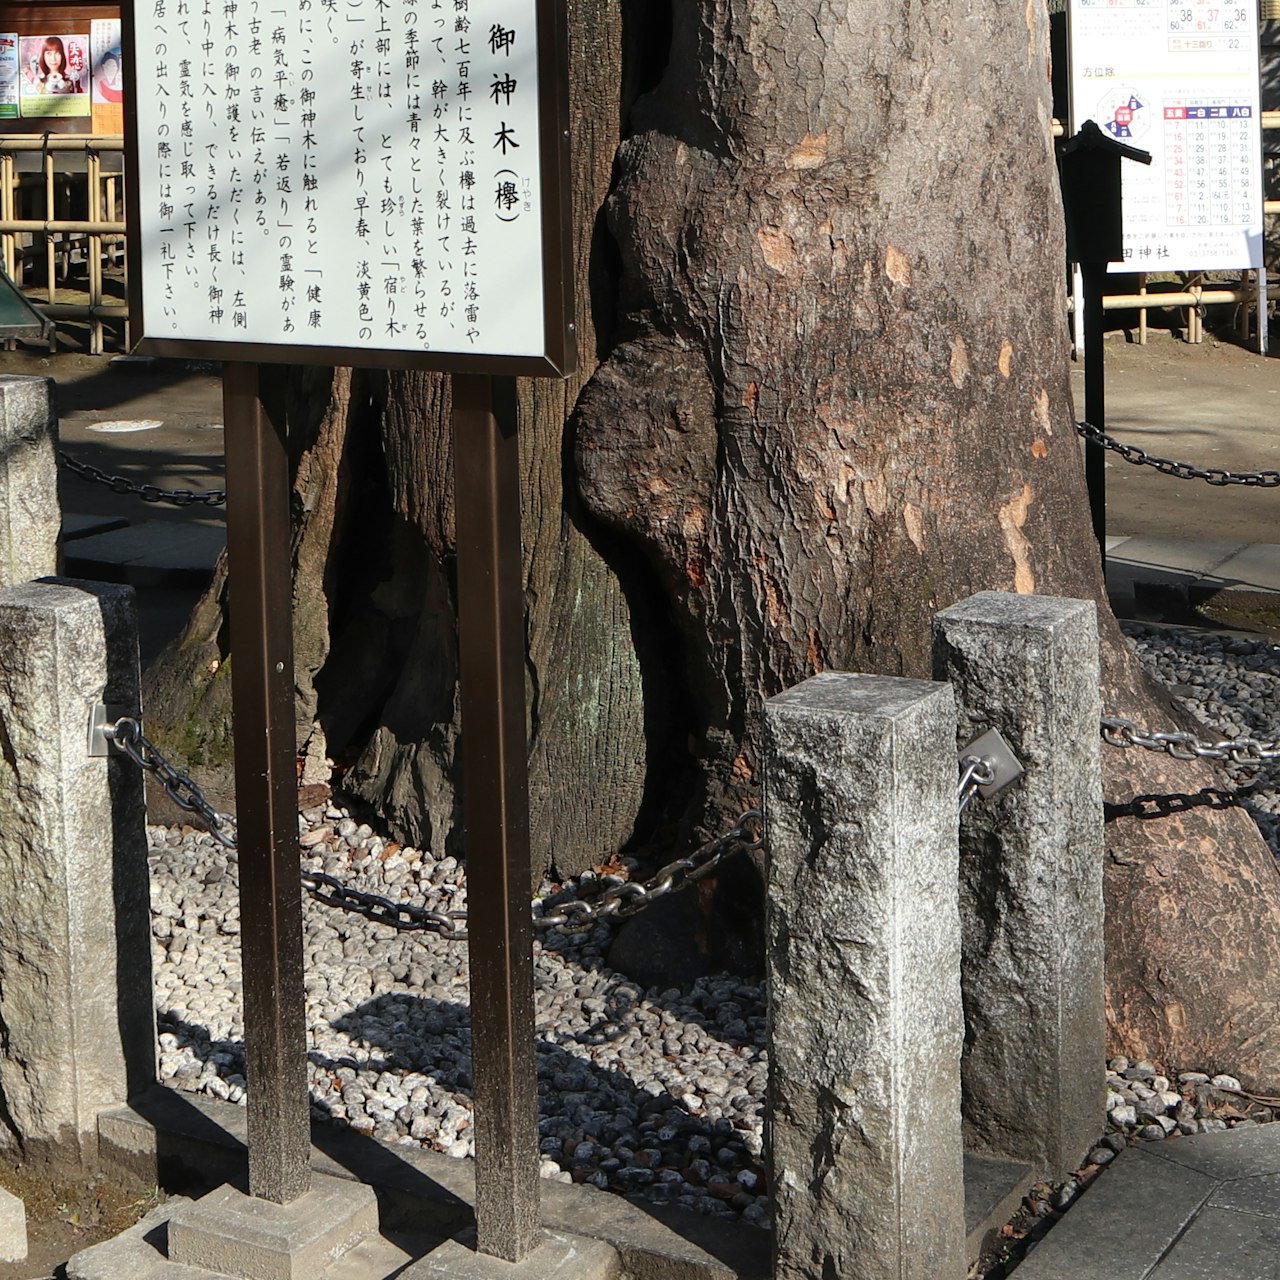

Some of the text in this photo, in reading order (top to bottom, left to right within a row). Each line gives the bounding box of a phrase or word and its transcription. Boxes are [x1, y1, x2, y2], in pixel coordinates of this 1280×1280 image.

[1181, 9, 1246, 22] 38 37 36
[1228, 39, 1239, 48] 22
[1083, 67, 1115, 77] 方位除
[1188, 108, 1205, 117] 一白
[1232, 108, 1249, 117] 八白
[521, 177, 532, 212] けやき
[1123, 244, 1170, 260] 田神社
